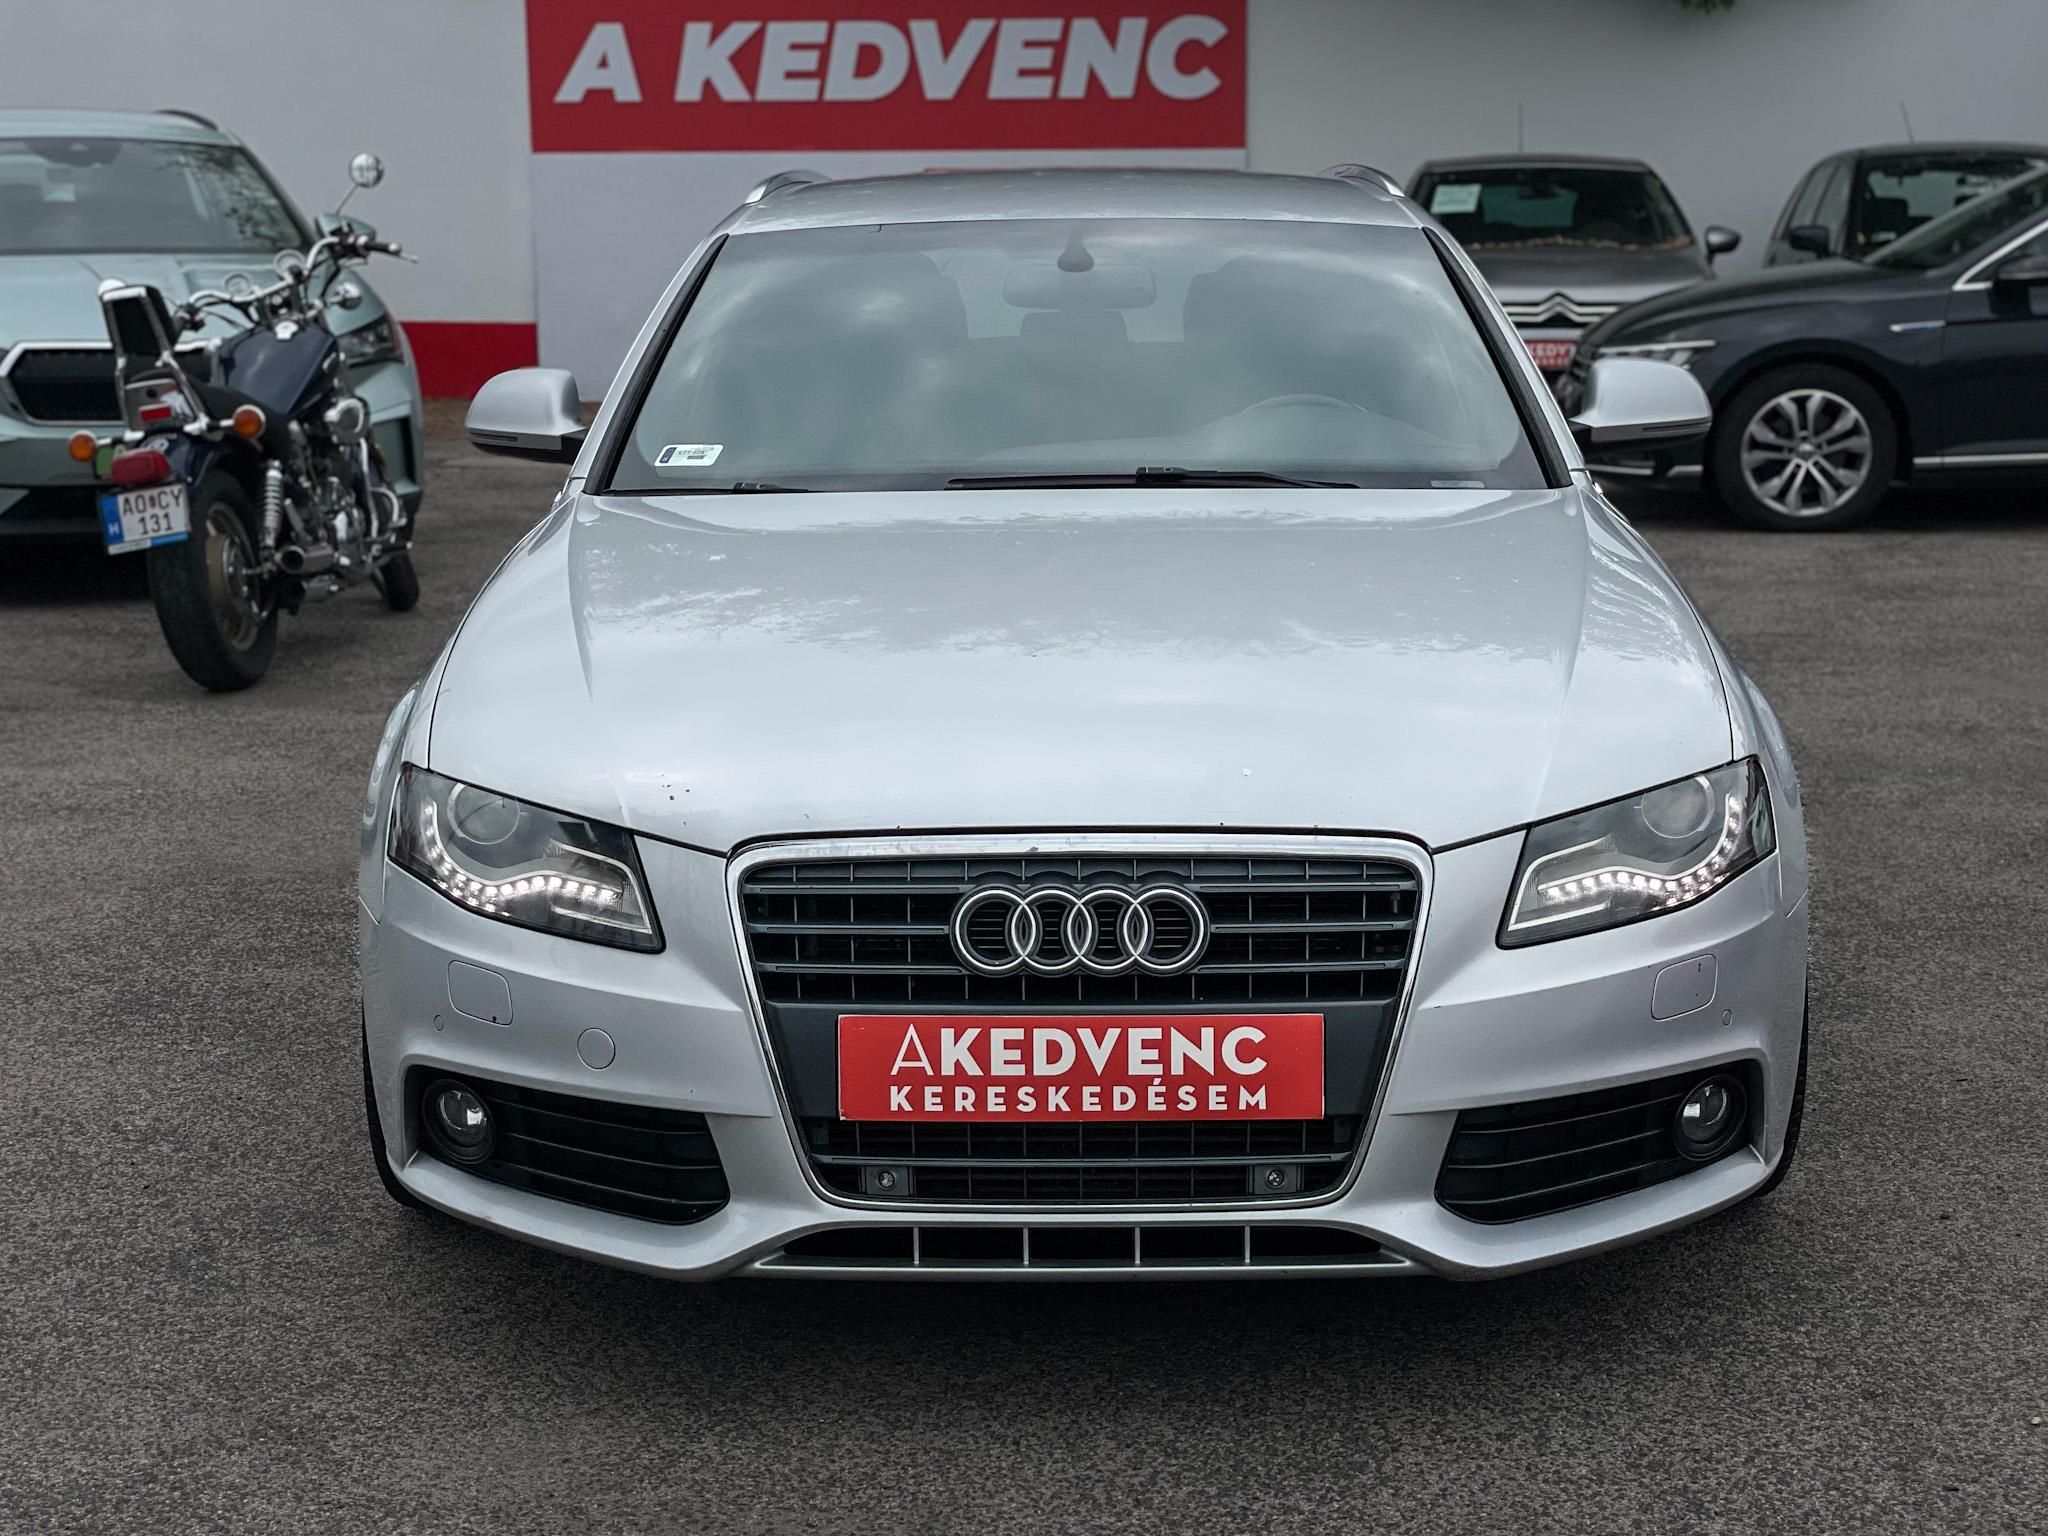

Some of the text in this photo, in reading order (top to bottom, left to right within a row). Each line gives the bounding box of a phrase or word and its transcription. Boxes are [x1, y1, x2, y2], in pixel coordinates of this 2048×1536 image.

[554, 15, 1229, 102] A KEDVENC
[138, 512, 173, 536] 131
[890, 1078, 1267, 1112] KERESKEDÉSEM
